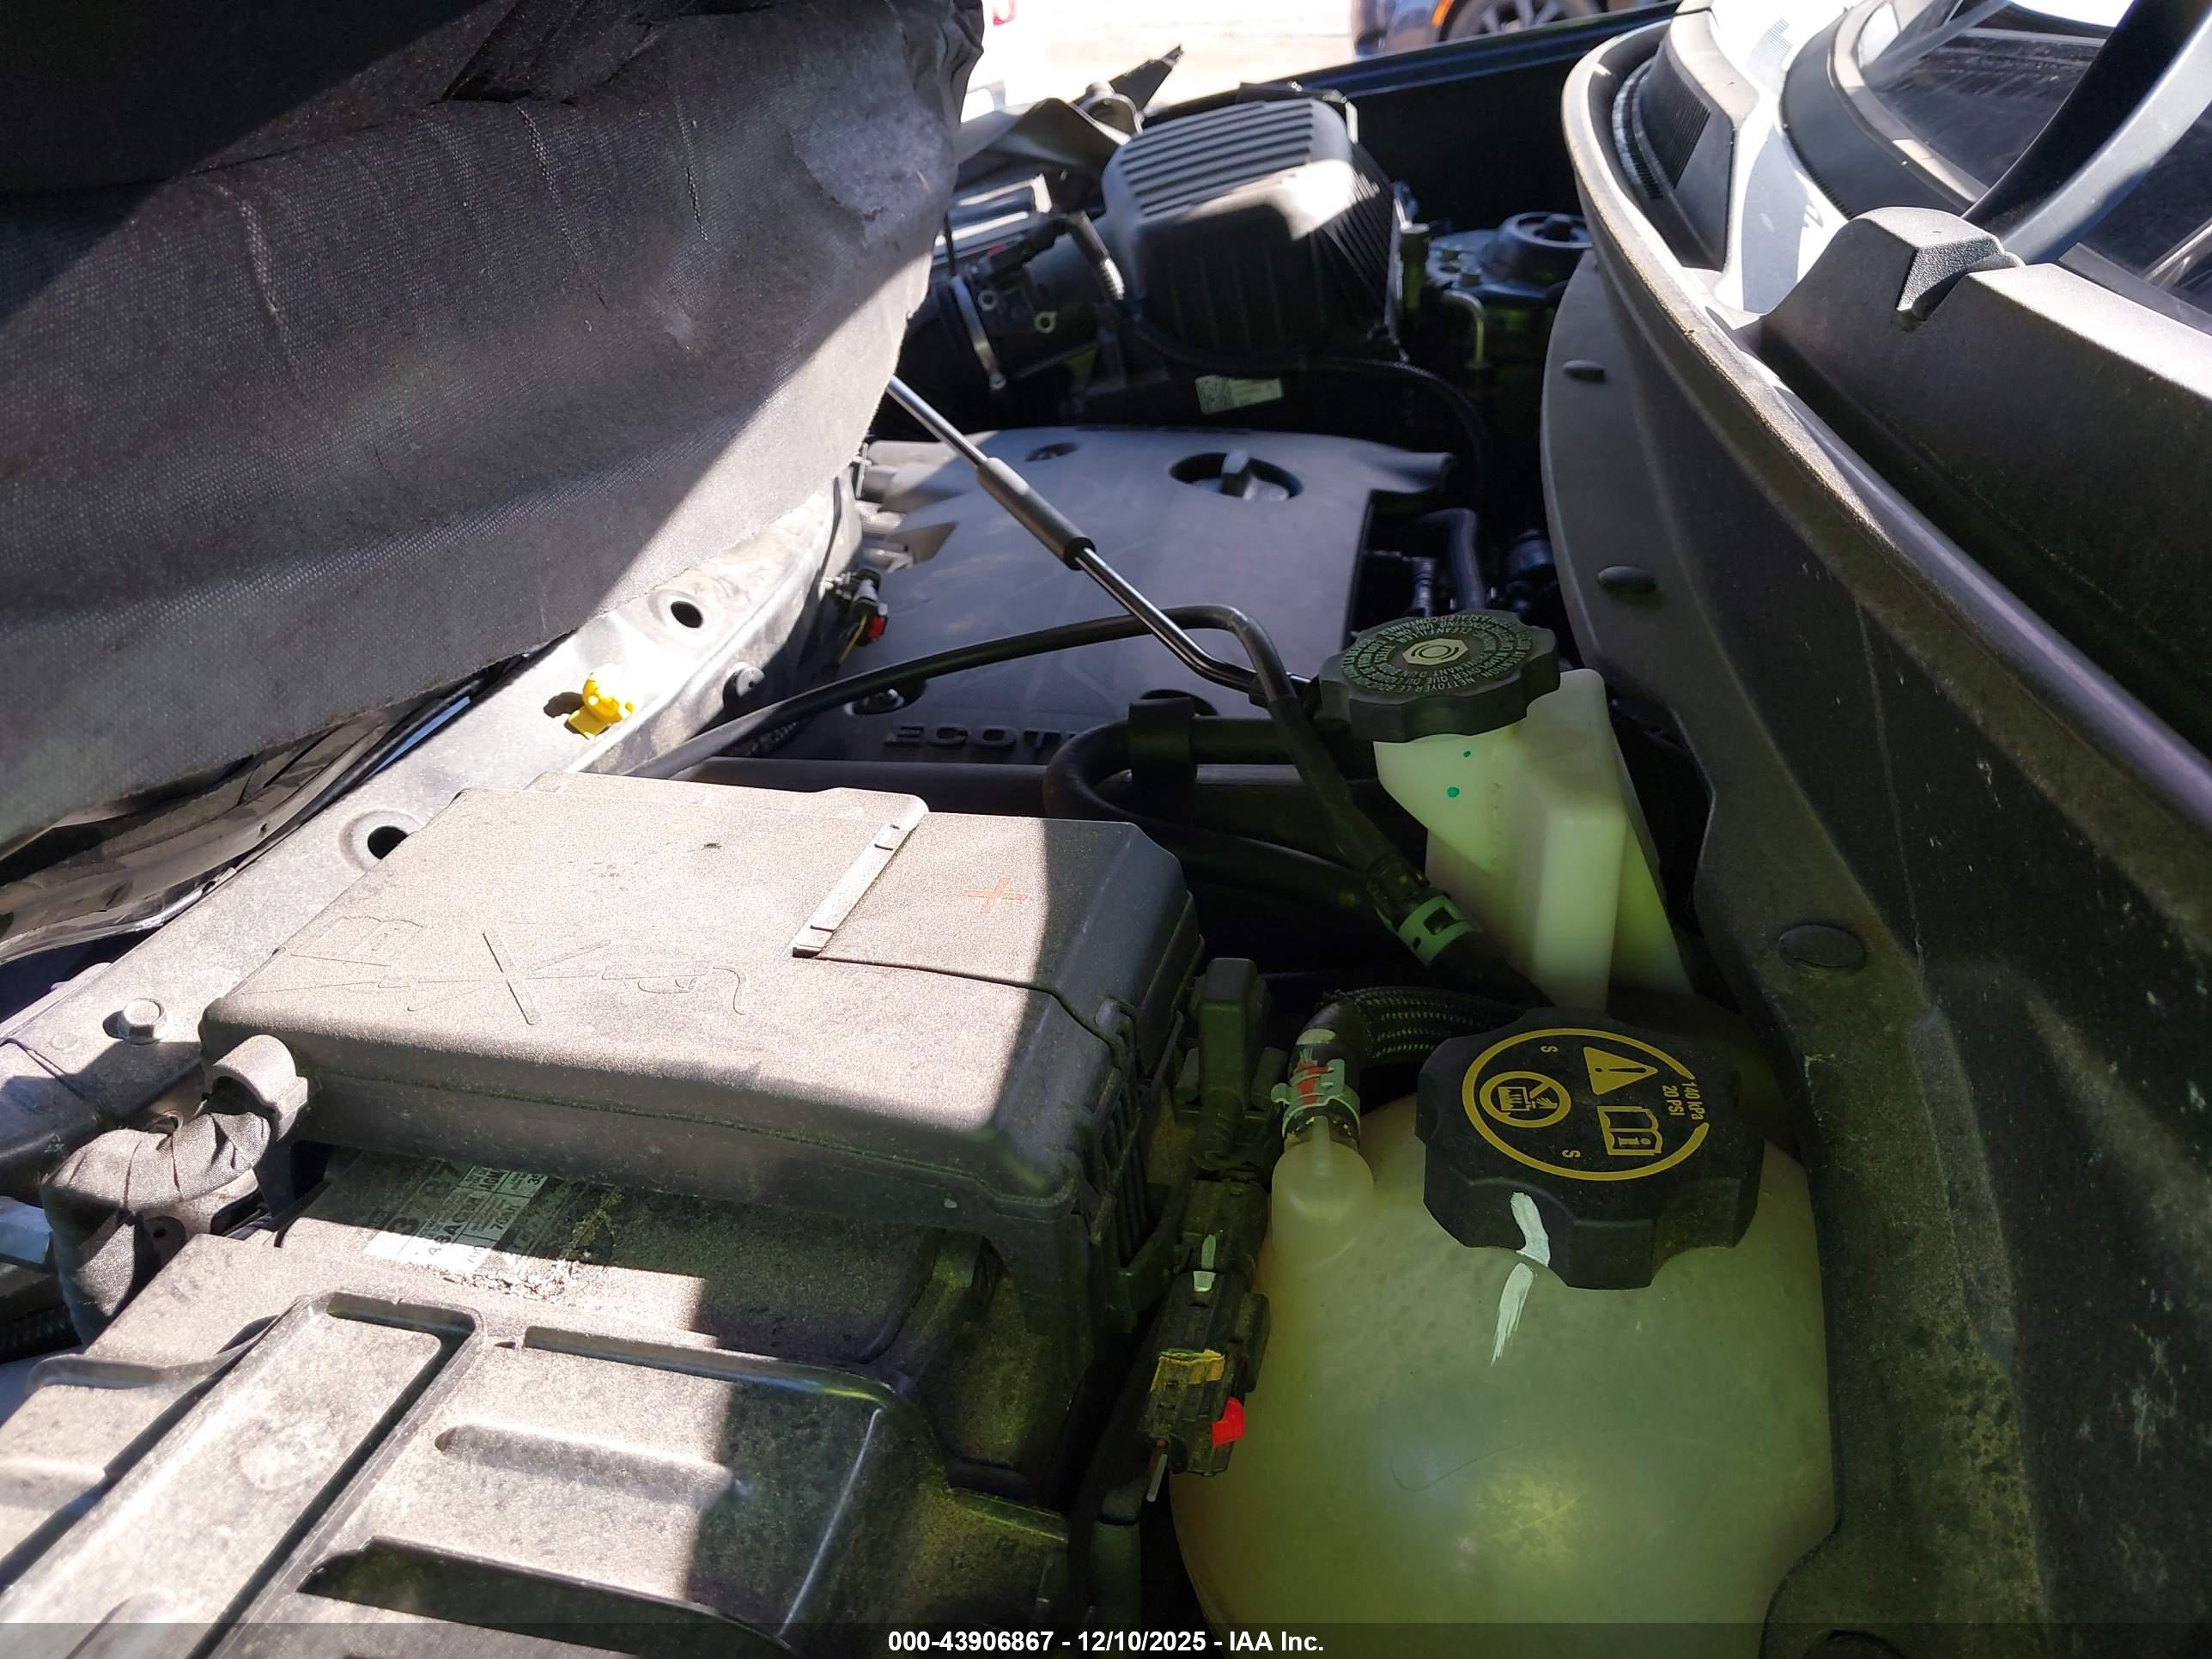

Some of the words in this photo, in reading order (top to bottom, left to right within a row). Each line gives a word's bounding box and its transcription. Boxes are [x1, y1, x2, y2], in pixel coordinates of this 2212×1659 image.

[1414, 677, 1475, 693] NETTOYER
[1662, 1085, 1680, 1097] 20
[1681, 1081, 1701, 1100] 140
[1666, 1098, 1686, 1116] PSI
[1686, 1101, 1705, 1120] kPa
